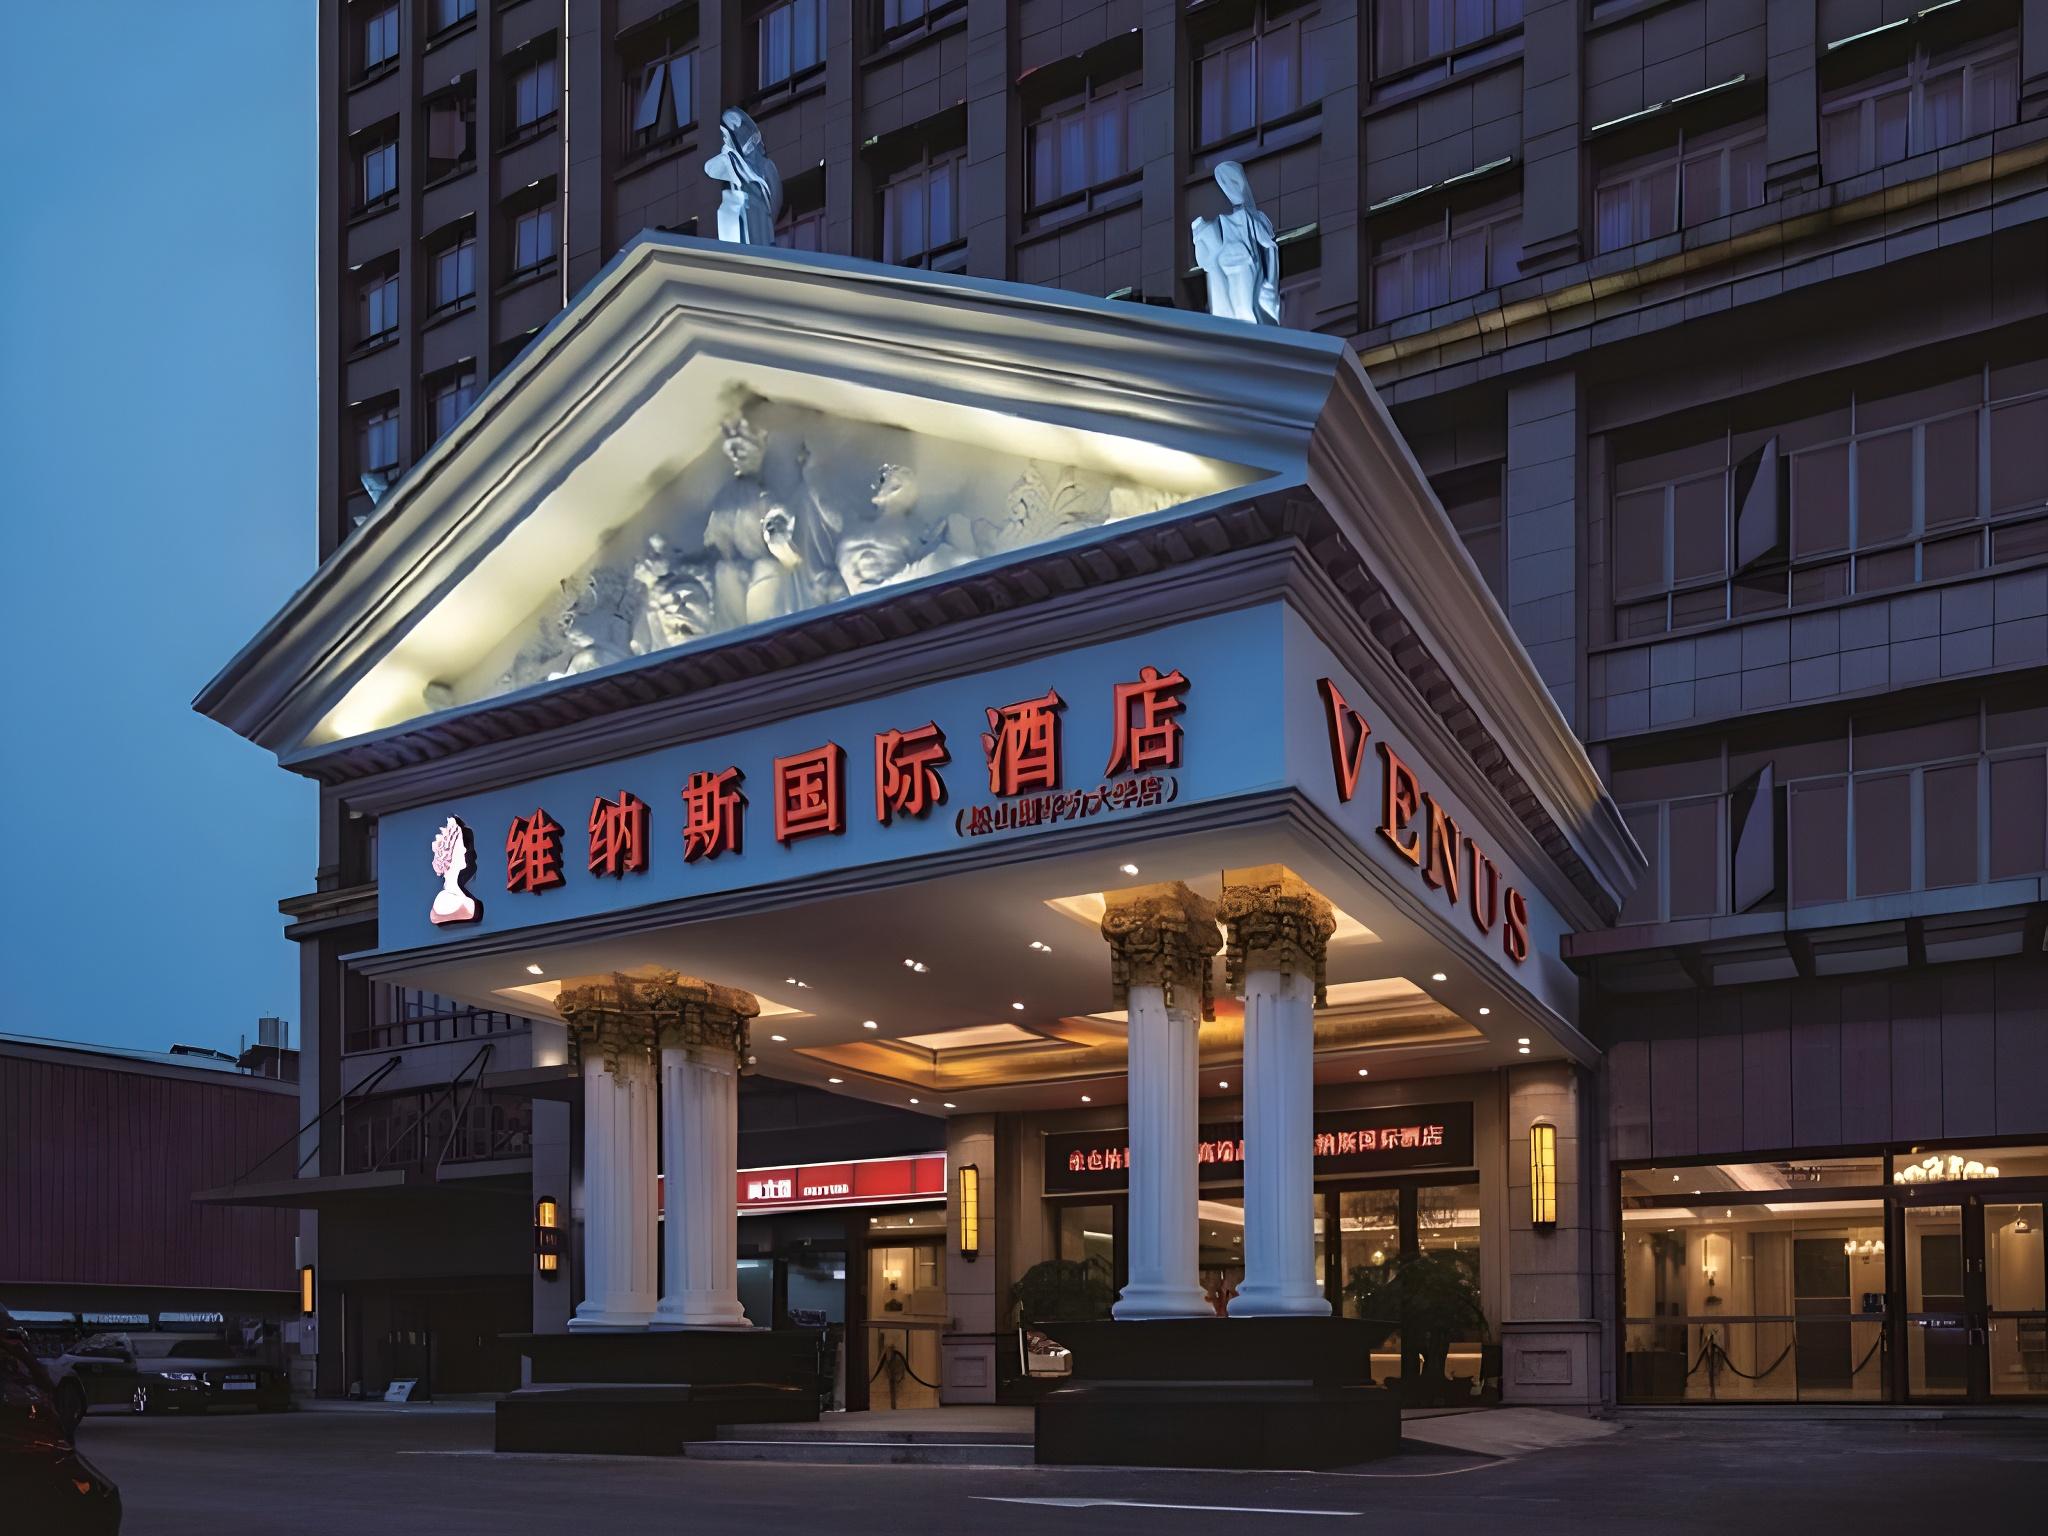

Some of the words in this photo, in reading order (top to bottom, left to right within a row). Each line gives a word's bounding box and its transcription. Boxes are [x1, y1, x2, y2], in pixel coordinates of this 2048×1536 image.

[505, 666, 1191, 894] 维纳斯国际酒店
[1317, 678, 1529, 963] VENUS
